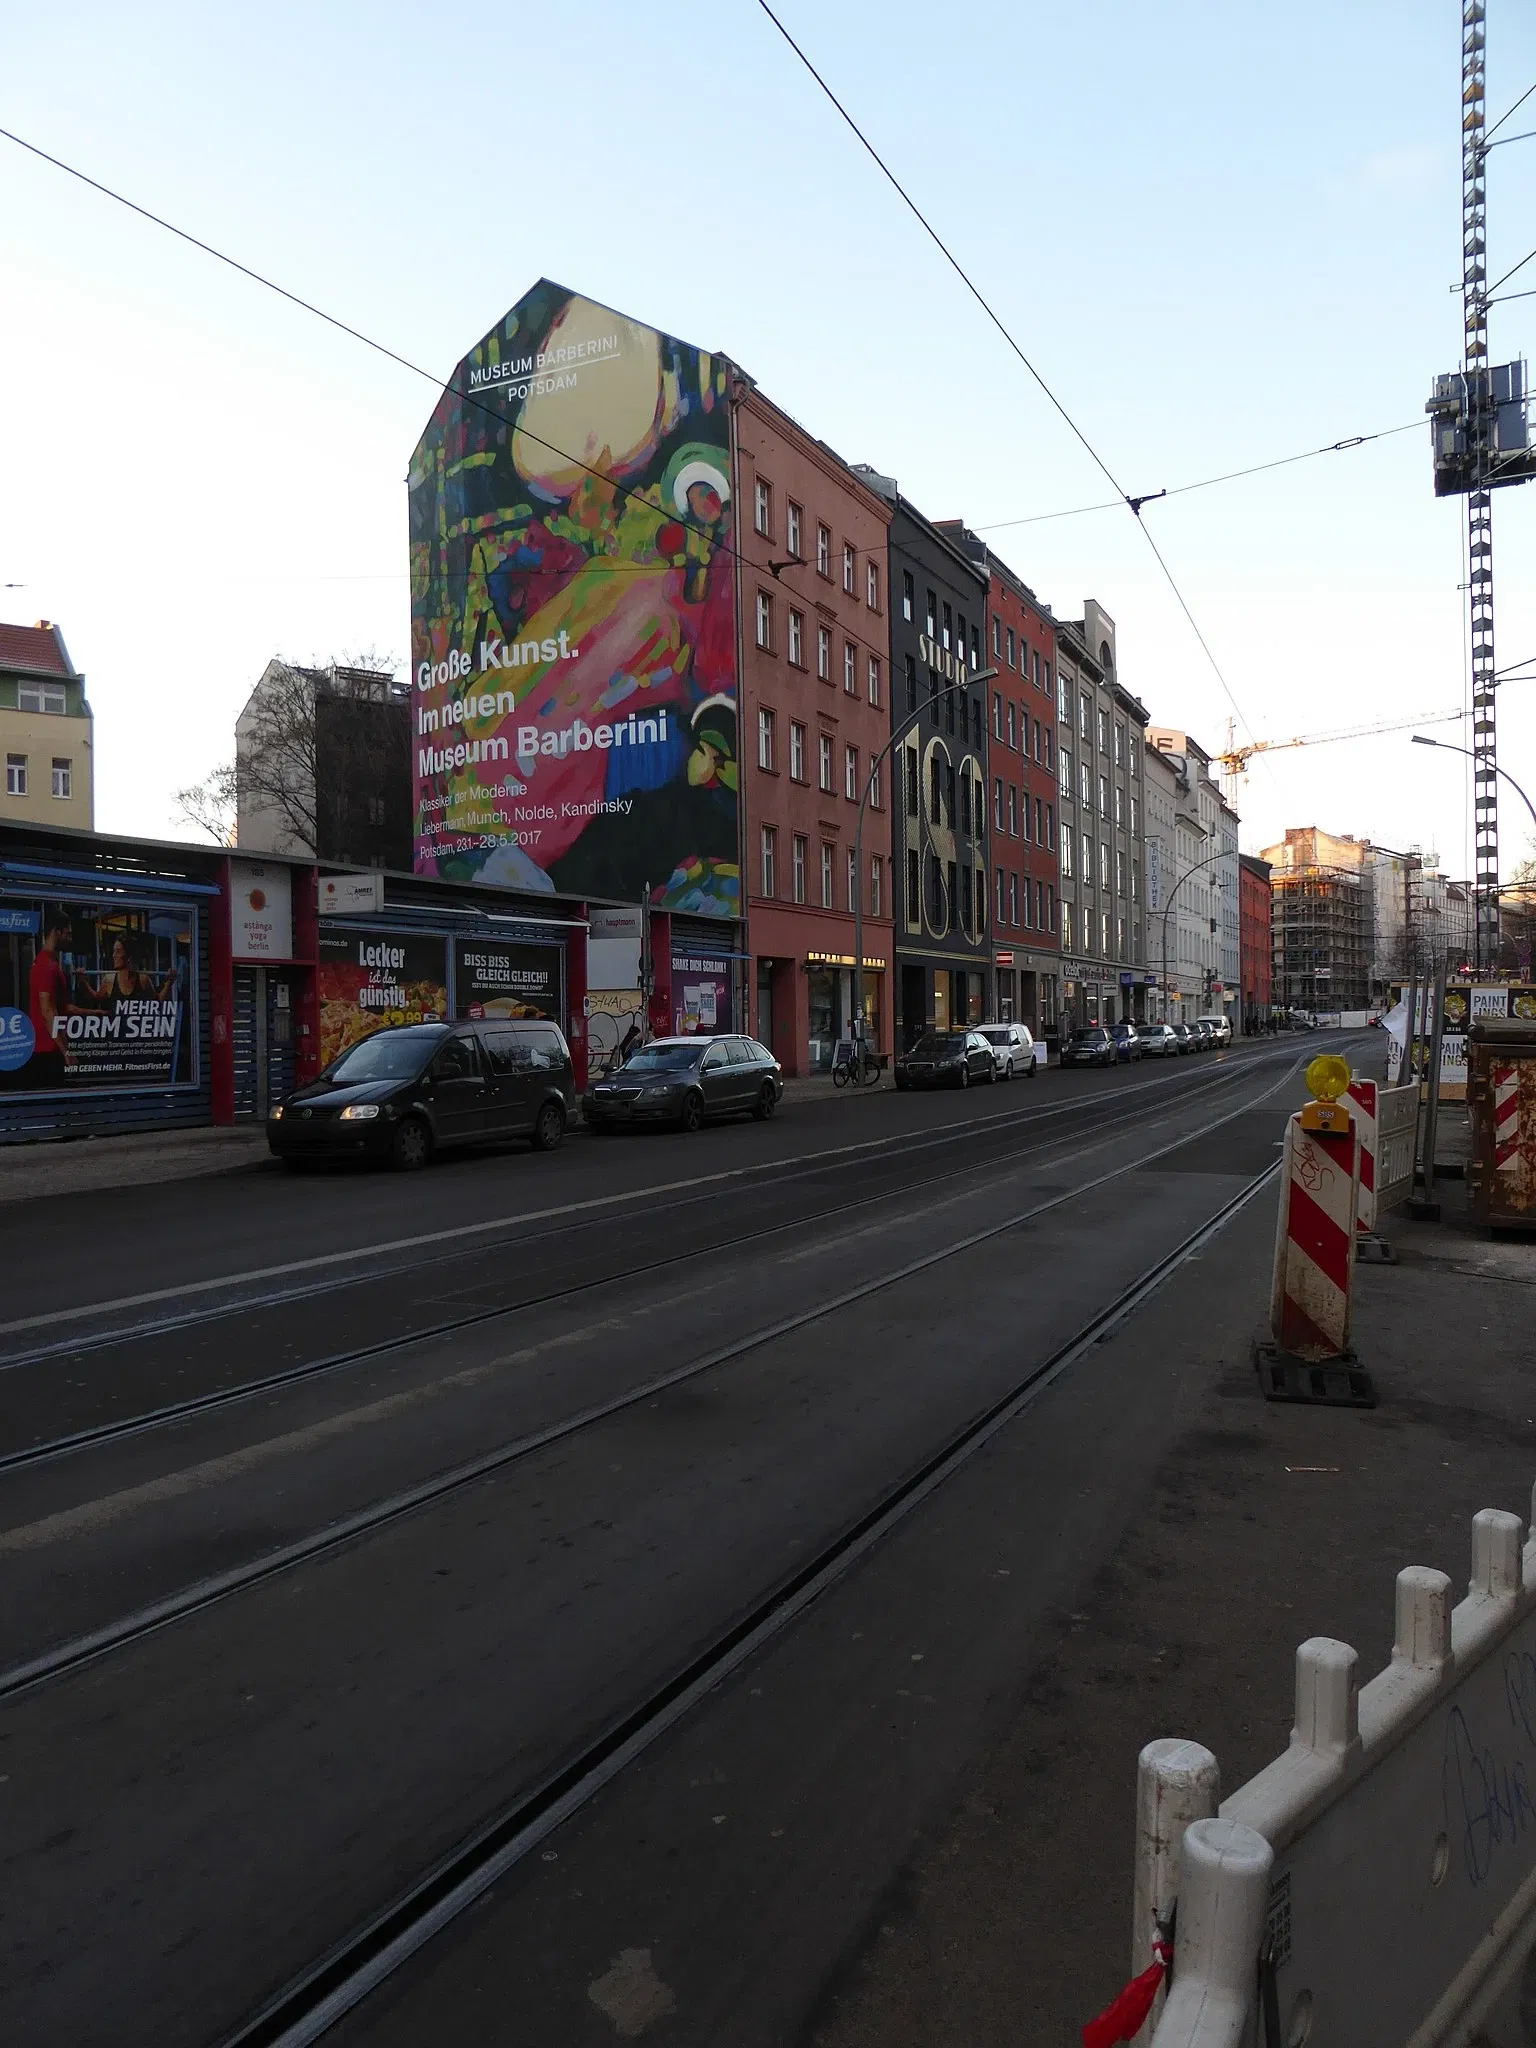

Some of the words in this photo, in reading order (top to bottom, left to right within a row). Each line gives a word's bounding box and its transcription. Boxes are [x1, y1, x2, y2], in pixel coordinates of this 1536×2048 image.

[470, 355, 533, 385] MUSEUM
[537, 335, 617, 368] BARBERINI
[508, 373, 577, 402] POTSDAM
[417, 649, 472, 692] Große
[480, 630, 579, 672] Kunst.
[919, 633, 968, 690] STUDIO
[418, 706, 438, 736] Im
[441, 690, 515, 728] neuen
[419, 735, 509, 778] Museum
[518, 709, 667, 758] Barberini
[419, 794, 453, 814] Klassiker
[454, 790, 468, 804] der
[469, 783, 528, 801] Moderne
[467, 808, 511, 826] Munch,
[514, 804, 558, 821] Nolde,
[561, 797, 634, 817] Kandinsky
[420, 842, 456, 860] Potsdam,
[248, 941, 270, 950] berlin
[250, 932, 267, 941] yoga
[359, 941, 406, 969] Lecker
[464, 953, 487, 967] BISS
[488, 955, 510, 969] BISS
[672, 957, 689, 971] SHAKE
[369, 969, 381, 984] ist
[382, 969, 397, 985] das
[476, 968, 510, 982] GLEICH
[511, 970, 549, 984] GLEICH!!
[115, 999, 160, 1016] MEHR
[162, 1000, 177, 1016] IN
[359, 985, 410, 1009] günstig.
[1474, 995, 1507, 1007] PAINT
[51, 1015, 121, 1039] FORM
[125, 1015, 177, 1039] SEIN
[1440, 1042, 1463, 1055] PAIN
[64, 1065, 79, 1073] WIR
[79, 1064, 102, 1073] GEBEN
[102, 1064, 125, 1072] MEHR.
[125, 1062, 171, 1071] FitnessFirst.de
